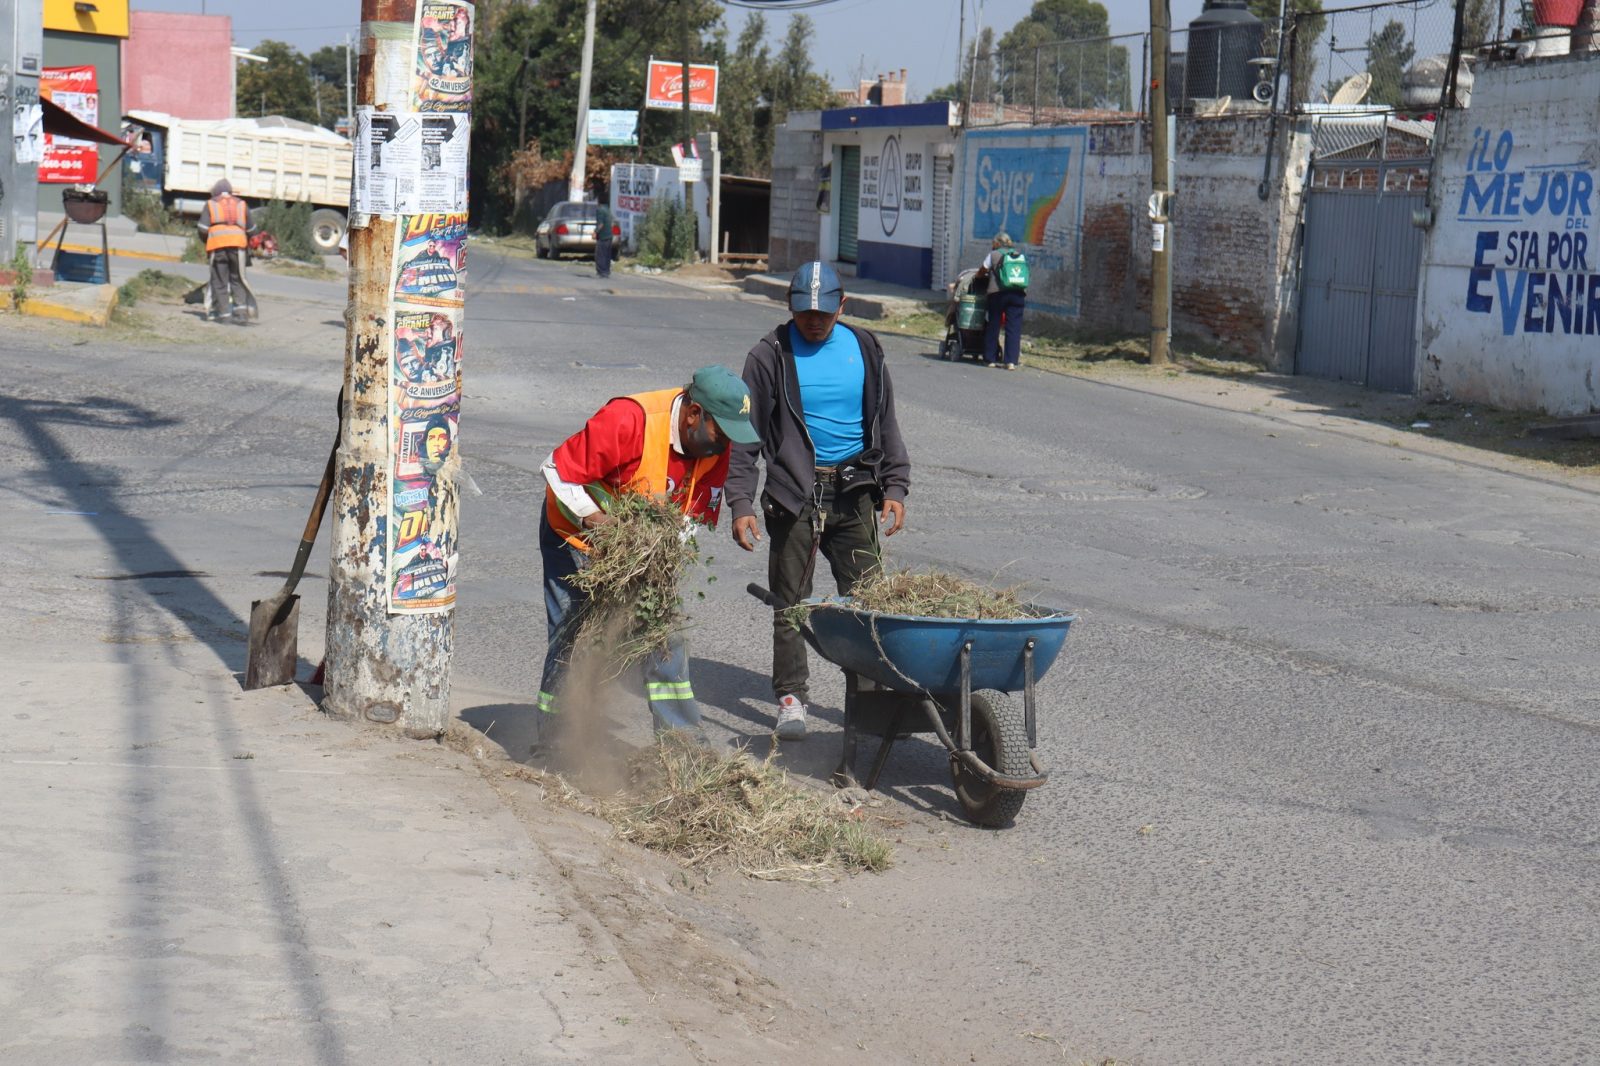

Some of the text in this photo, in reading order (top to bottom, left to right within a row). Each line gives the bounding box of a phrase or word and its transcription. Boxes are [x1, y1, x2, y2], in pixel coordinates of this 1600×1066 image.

[423, 11, 455, 20] GIGANTE
[978, 155, 1034, 230] Sayer
[1458, 171, 1593, 216] MEJOR
[1565, 218, 1589, 229] DEL
[1546, 231, 1588, 270] POR
[397, 320, 430, 328] GIGANTE
[408, 387, 420, 396] 42
